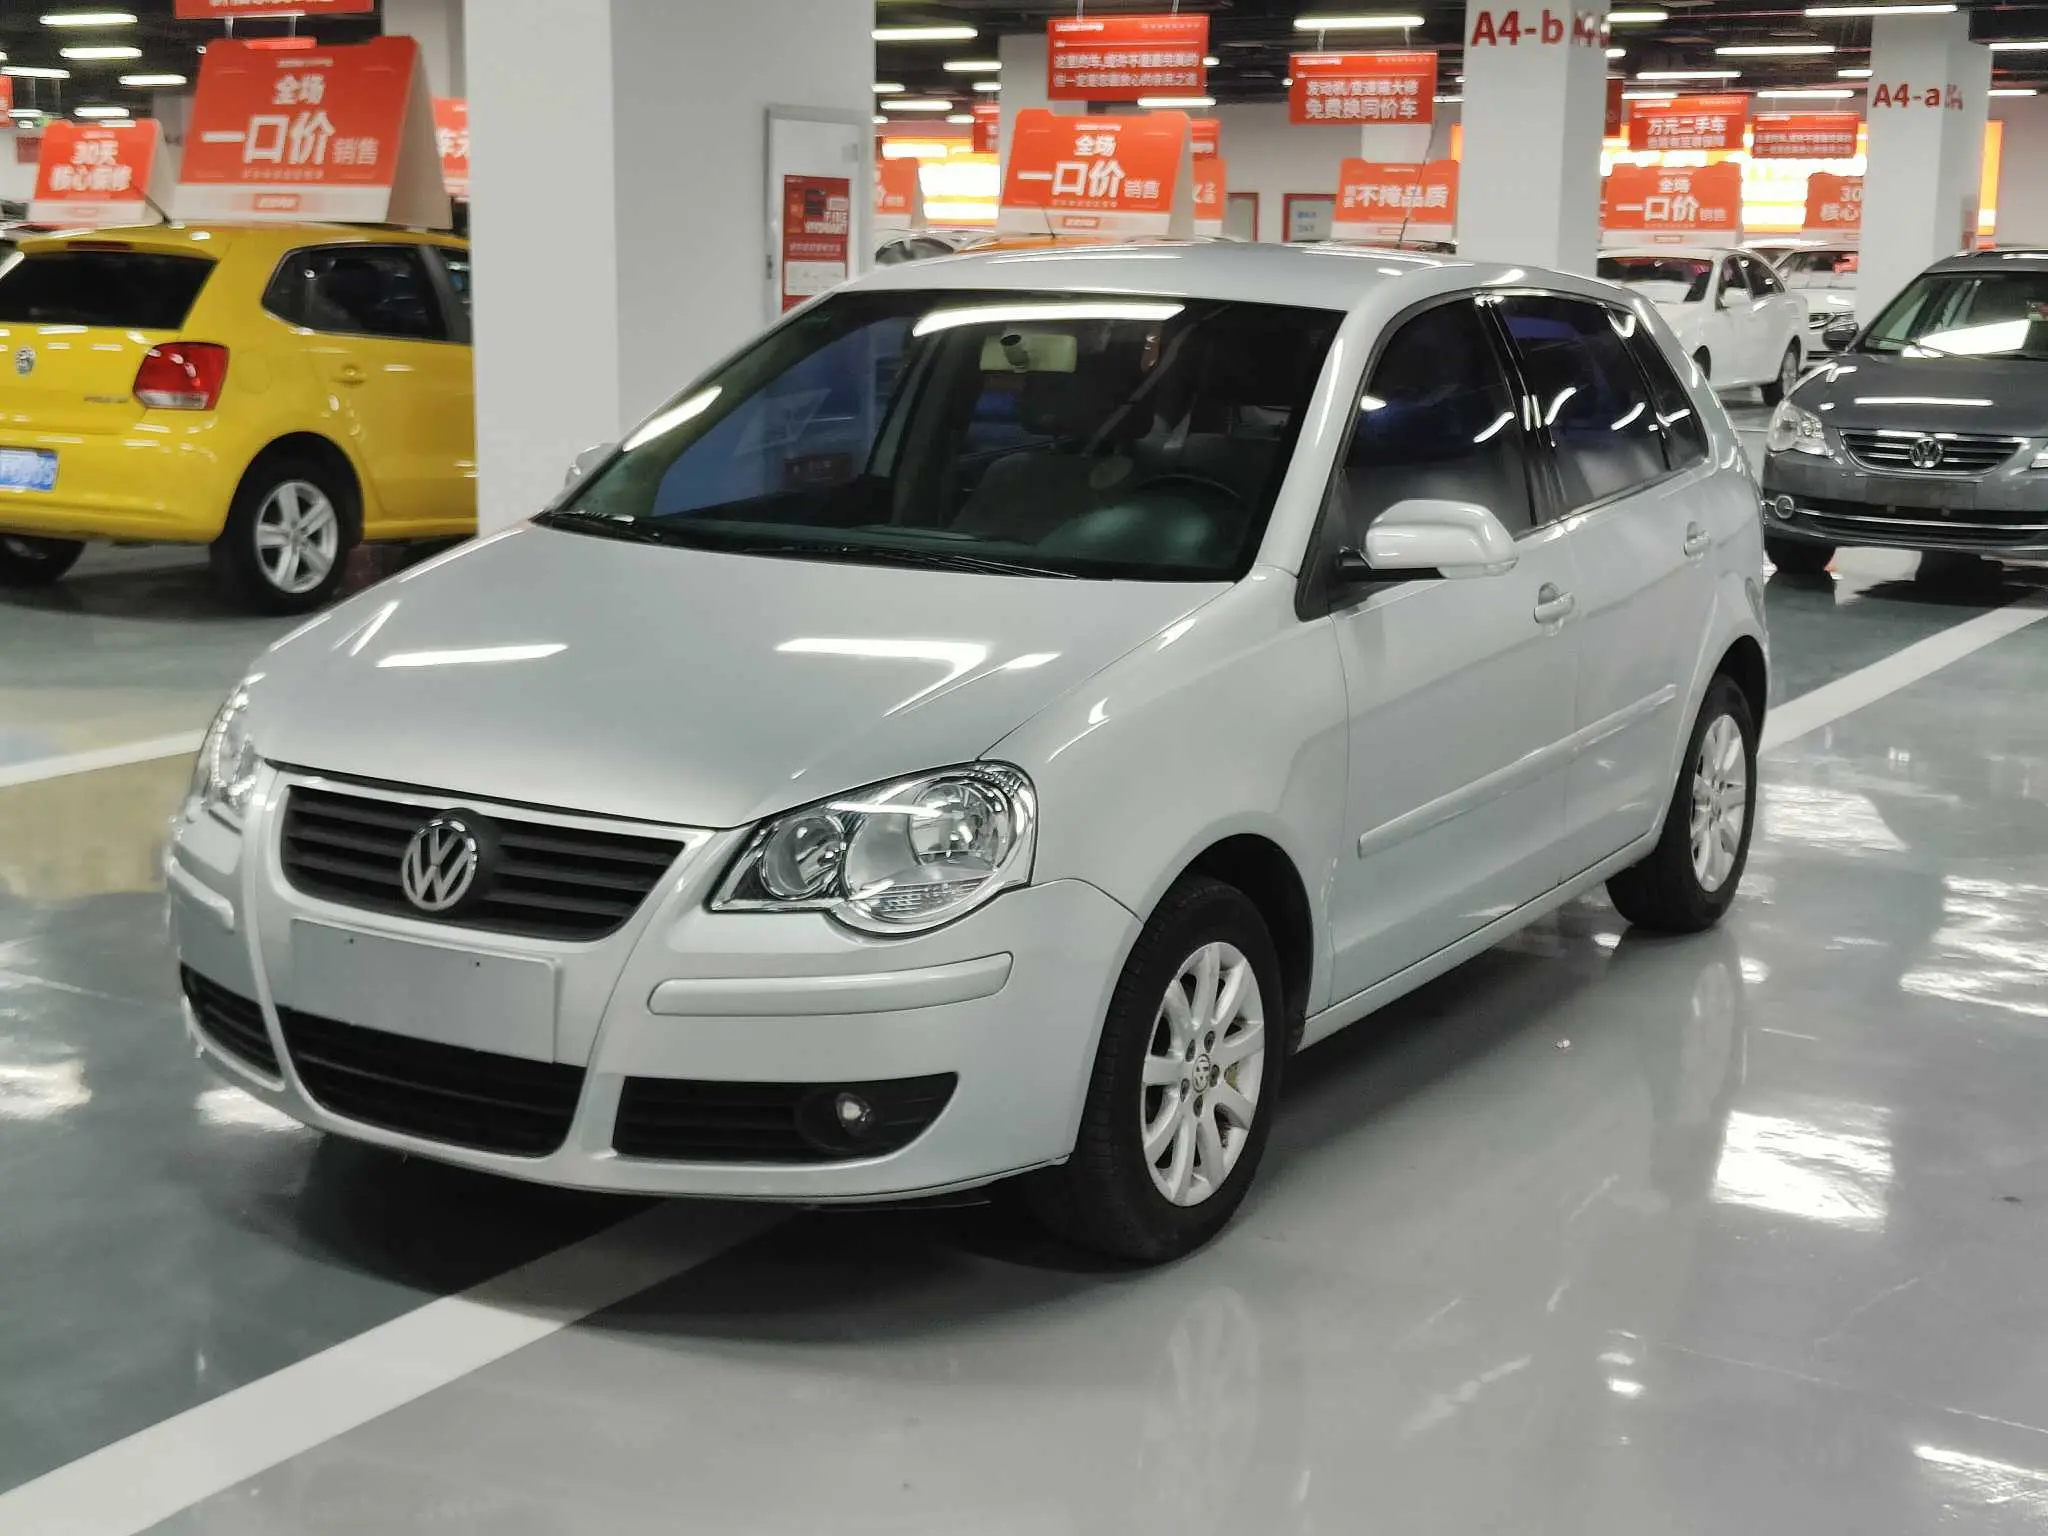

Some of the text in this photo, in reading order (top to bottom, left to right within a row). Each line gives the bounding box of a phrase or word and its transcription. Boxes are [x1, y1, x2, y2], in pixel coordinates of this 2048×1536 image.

[1472, 10, 1564, 46] A4-b
[272, 73, 326, 104] 全场
[1872, 83, 1940, 108] A4-a
[1305, 96, 1419, 119] 免费换同价车
[1647, 116, 1727, 135] 万元二手车
[1074, 135, 1117, 157] 全场
[1658, 177, 1691, 193] 全场
[402, 819, 477, 911] VW
